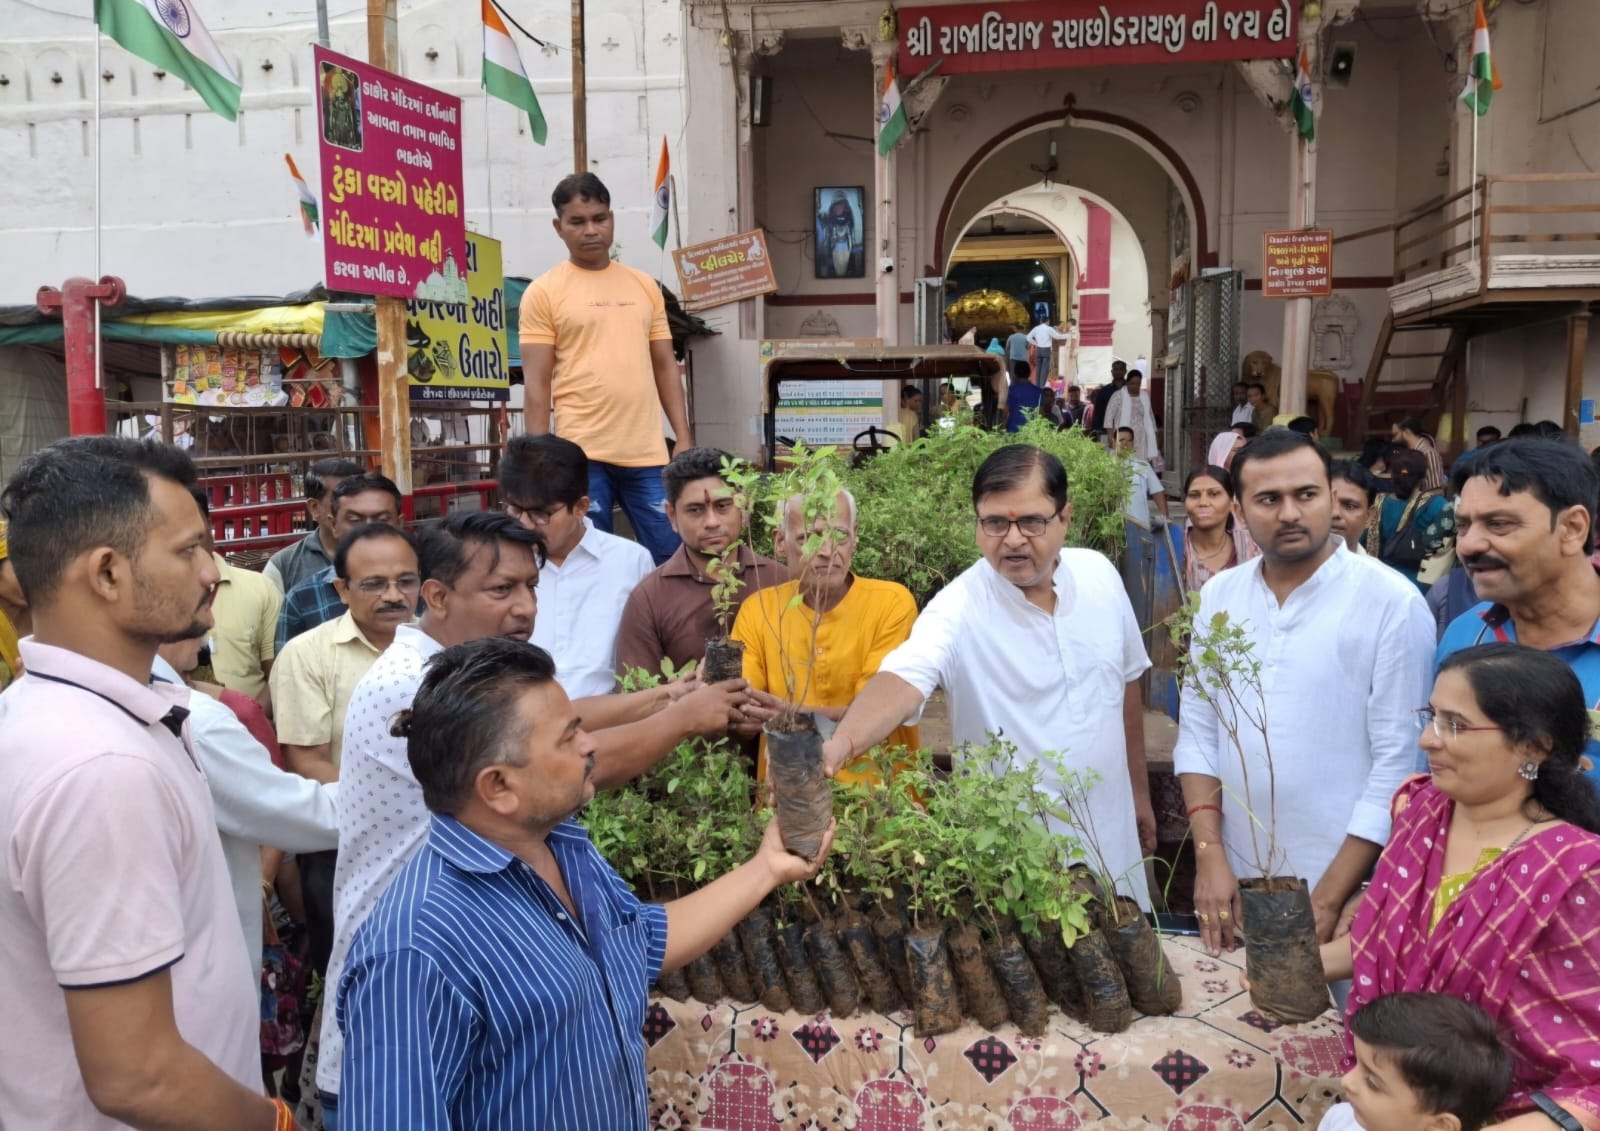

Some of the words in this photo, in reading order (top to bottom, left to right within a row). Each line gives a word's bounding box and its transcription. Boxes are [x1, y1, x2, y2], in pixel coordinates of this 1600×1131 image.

[906, 16, 932, 57] શ્રી
[939, 10, 1044, 56] રાજાધિરાજ
[1051, 6, 1187, 54] રણછોડરાયજી
[1191, 1, 1218, 42] ની
[1223, 9, 1261, 39] જય
[1267, 0, 1291, 41] હો
[363, 80, 389, 102] ડાકોર
[391, 88, 423, 114] મંદિરમાં
[367, 111, 400, 133] આવતા
[402, 124, 426, 142] તમામ
[428, 129, 456, 150] ભાવિક
[367, 169, 407, 206] વસ્ત્રો
[411, 177, 458, 218] પહેરીને
[328, 209, 380, 251] મંદિરમાં
[383, 221, 416, 258] પ્રવેશ
[419, 229, 442, 264] નહી
[333, 260, 360, 279] કરવા
[362, 262, 395, 283] અપીલ
[397, 265, 411, 286] છે.
[700, 250, 746, 271] વ્હીલચેર
[1307, 265, 1327, 275] સેવા
